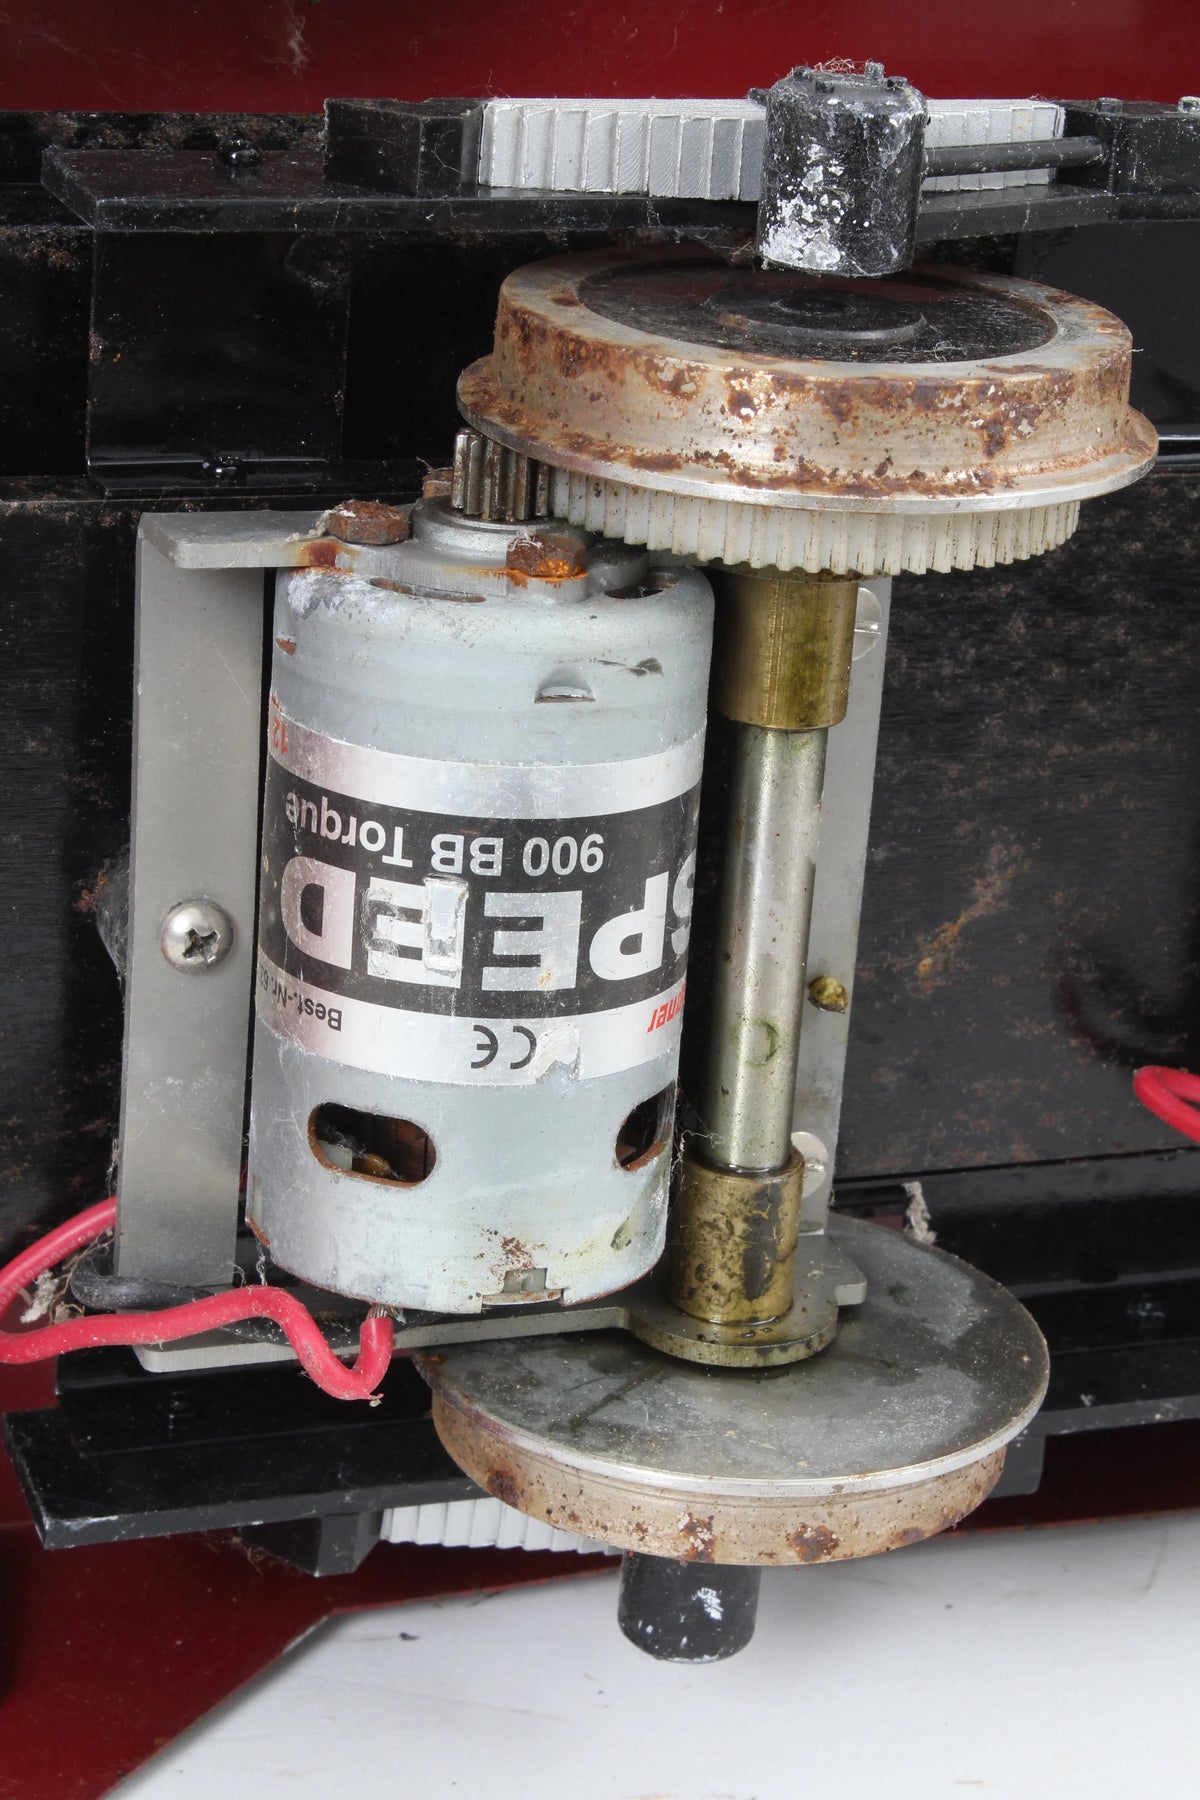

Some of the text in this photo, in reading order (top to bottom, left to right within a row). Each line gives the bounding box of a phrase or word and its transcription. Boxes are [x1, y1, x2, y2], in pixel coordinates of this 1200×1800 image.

[285, 791, 605, 876] 900 BB Torque
[280, 850, 697, 991] SPEED
